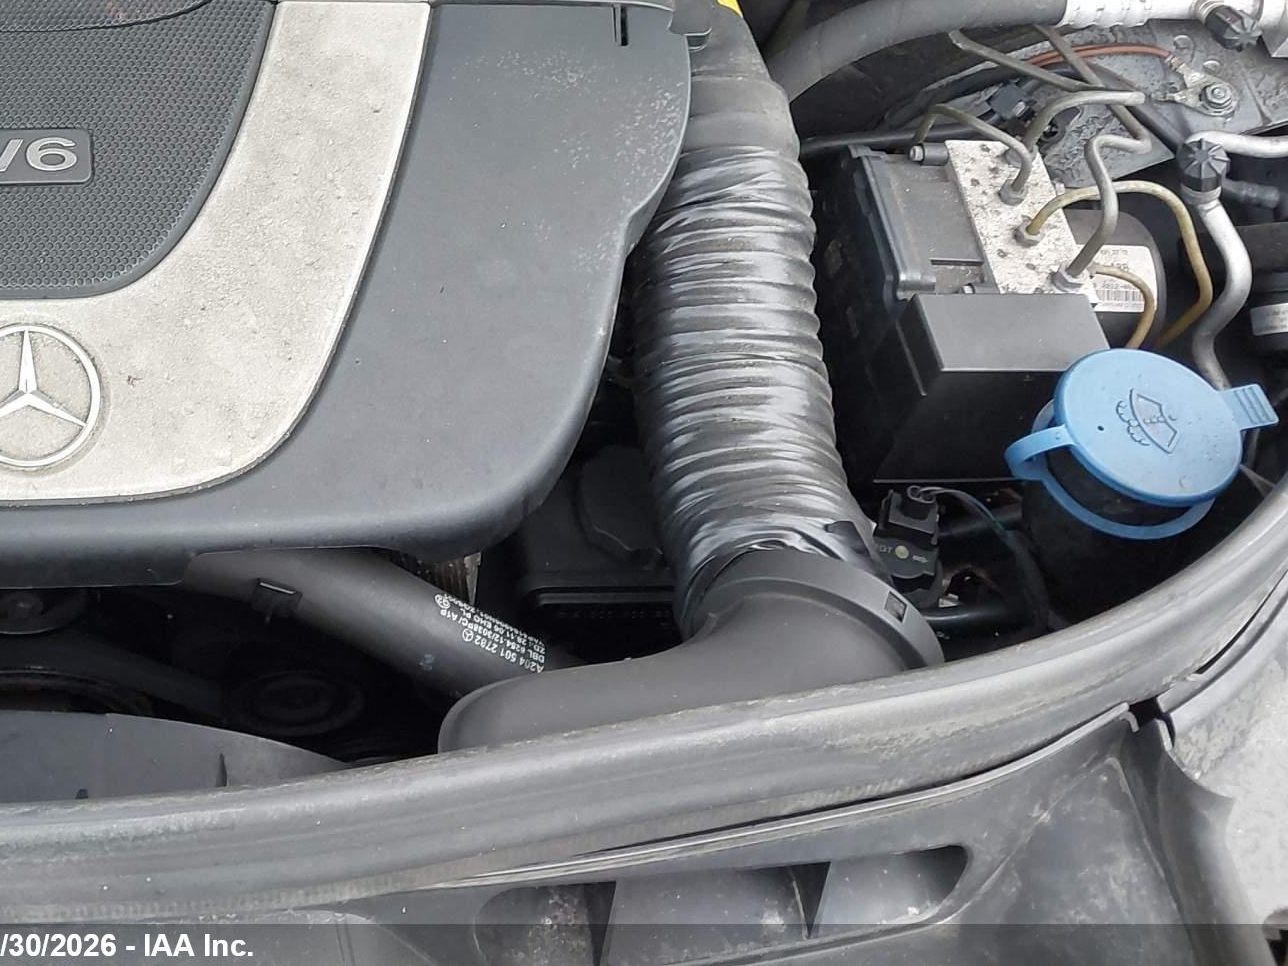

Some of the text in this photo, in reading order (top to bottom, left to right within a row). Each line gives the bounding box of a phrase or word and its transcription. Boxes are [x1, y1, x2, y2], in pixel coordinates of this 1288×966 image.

[474, 635, 499, 654] 2782
[499, 647, 517, 663] 501
[527, 648, 545, 664] DBL
[519, 656, 545, 674] A204
